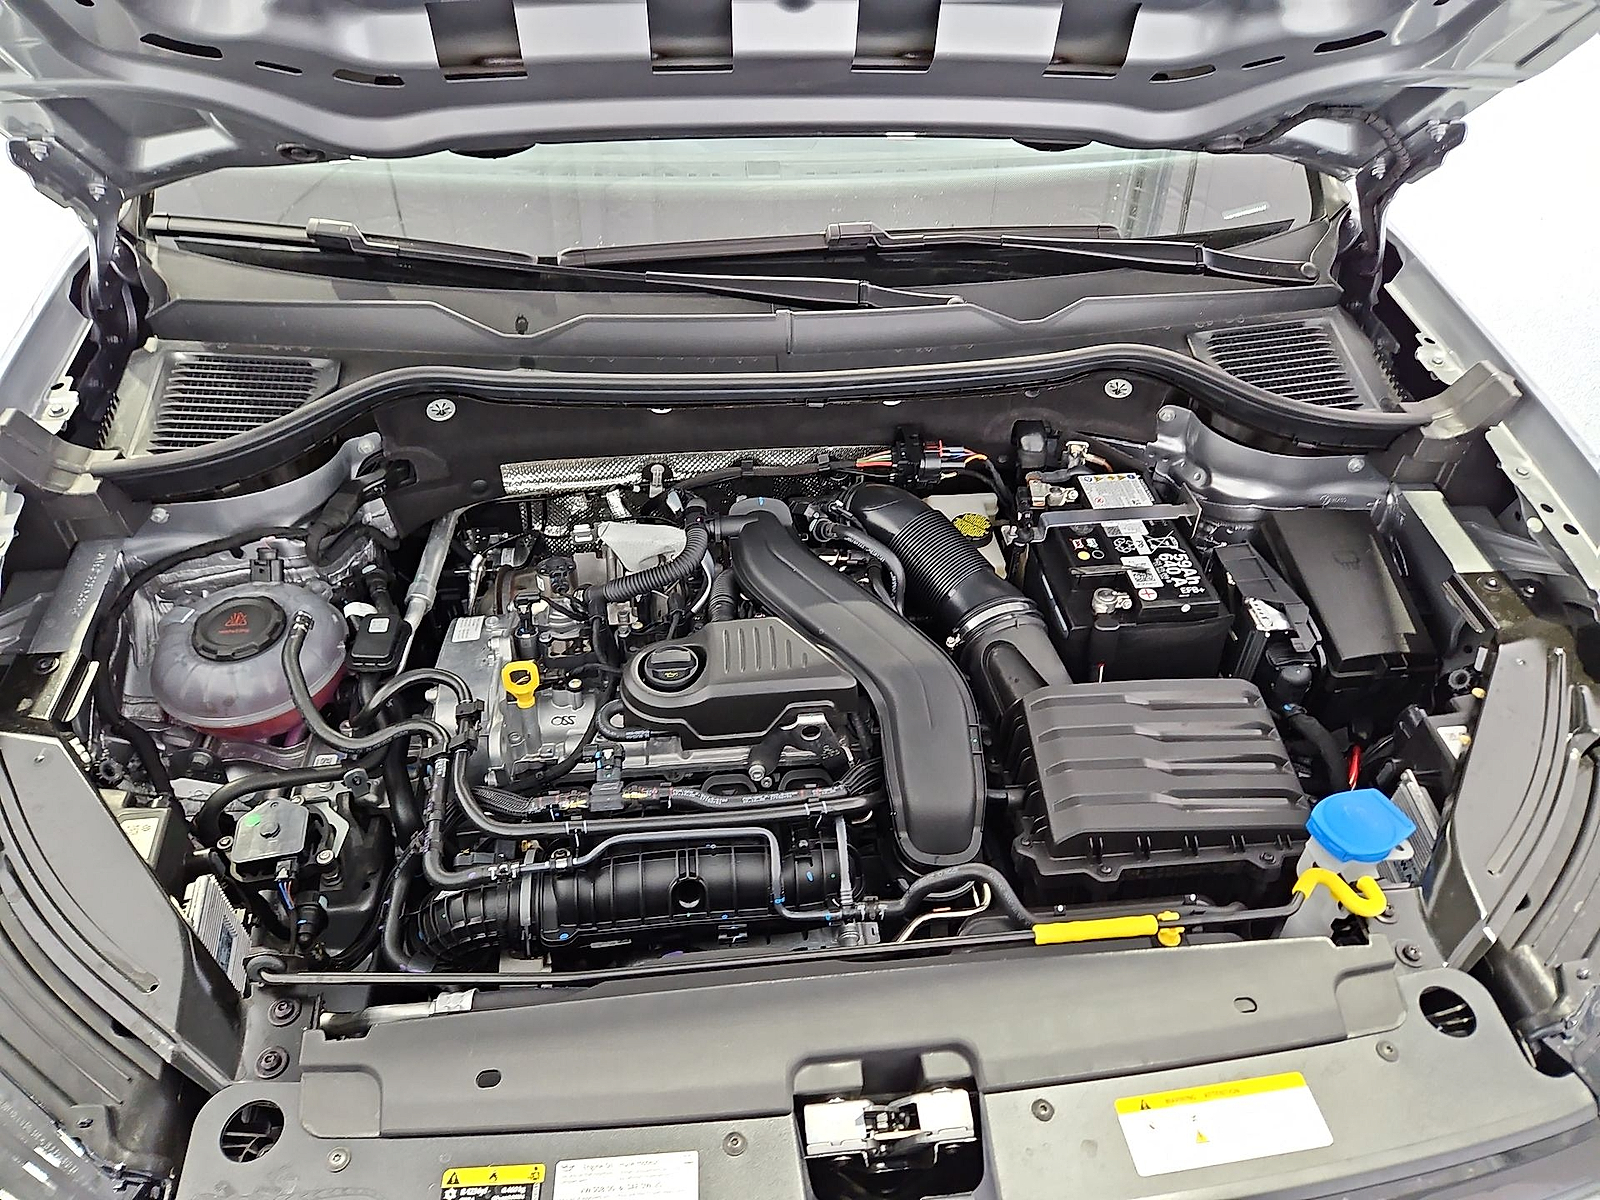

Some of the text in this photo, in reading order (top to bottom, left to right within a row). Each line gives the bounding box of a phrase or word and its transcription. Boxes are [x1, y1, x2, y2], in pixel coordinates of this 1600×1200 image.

[1158, 552, 1182, 575] 640
[1170, 576, 1189, 588] A
[1174, 553, 1202, 586] 59Ah
